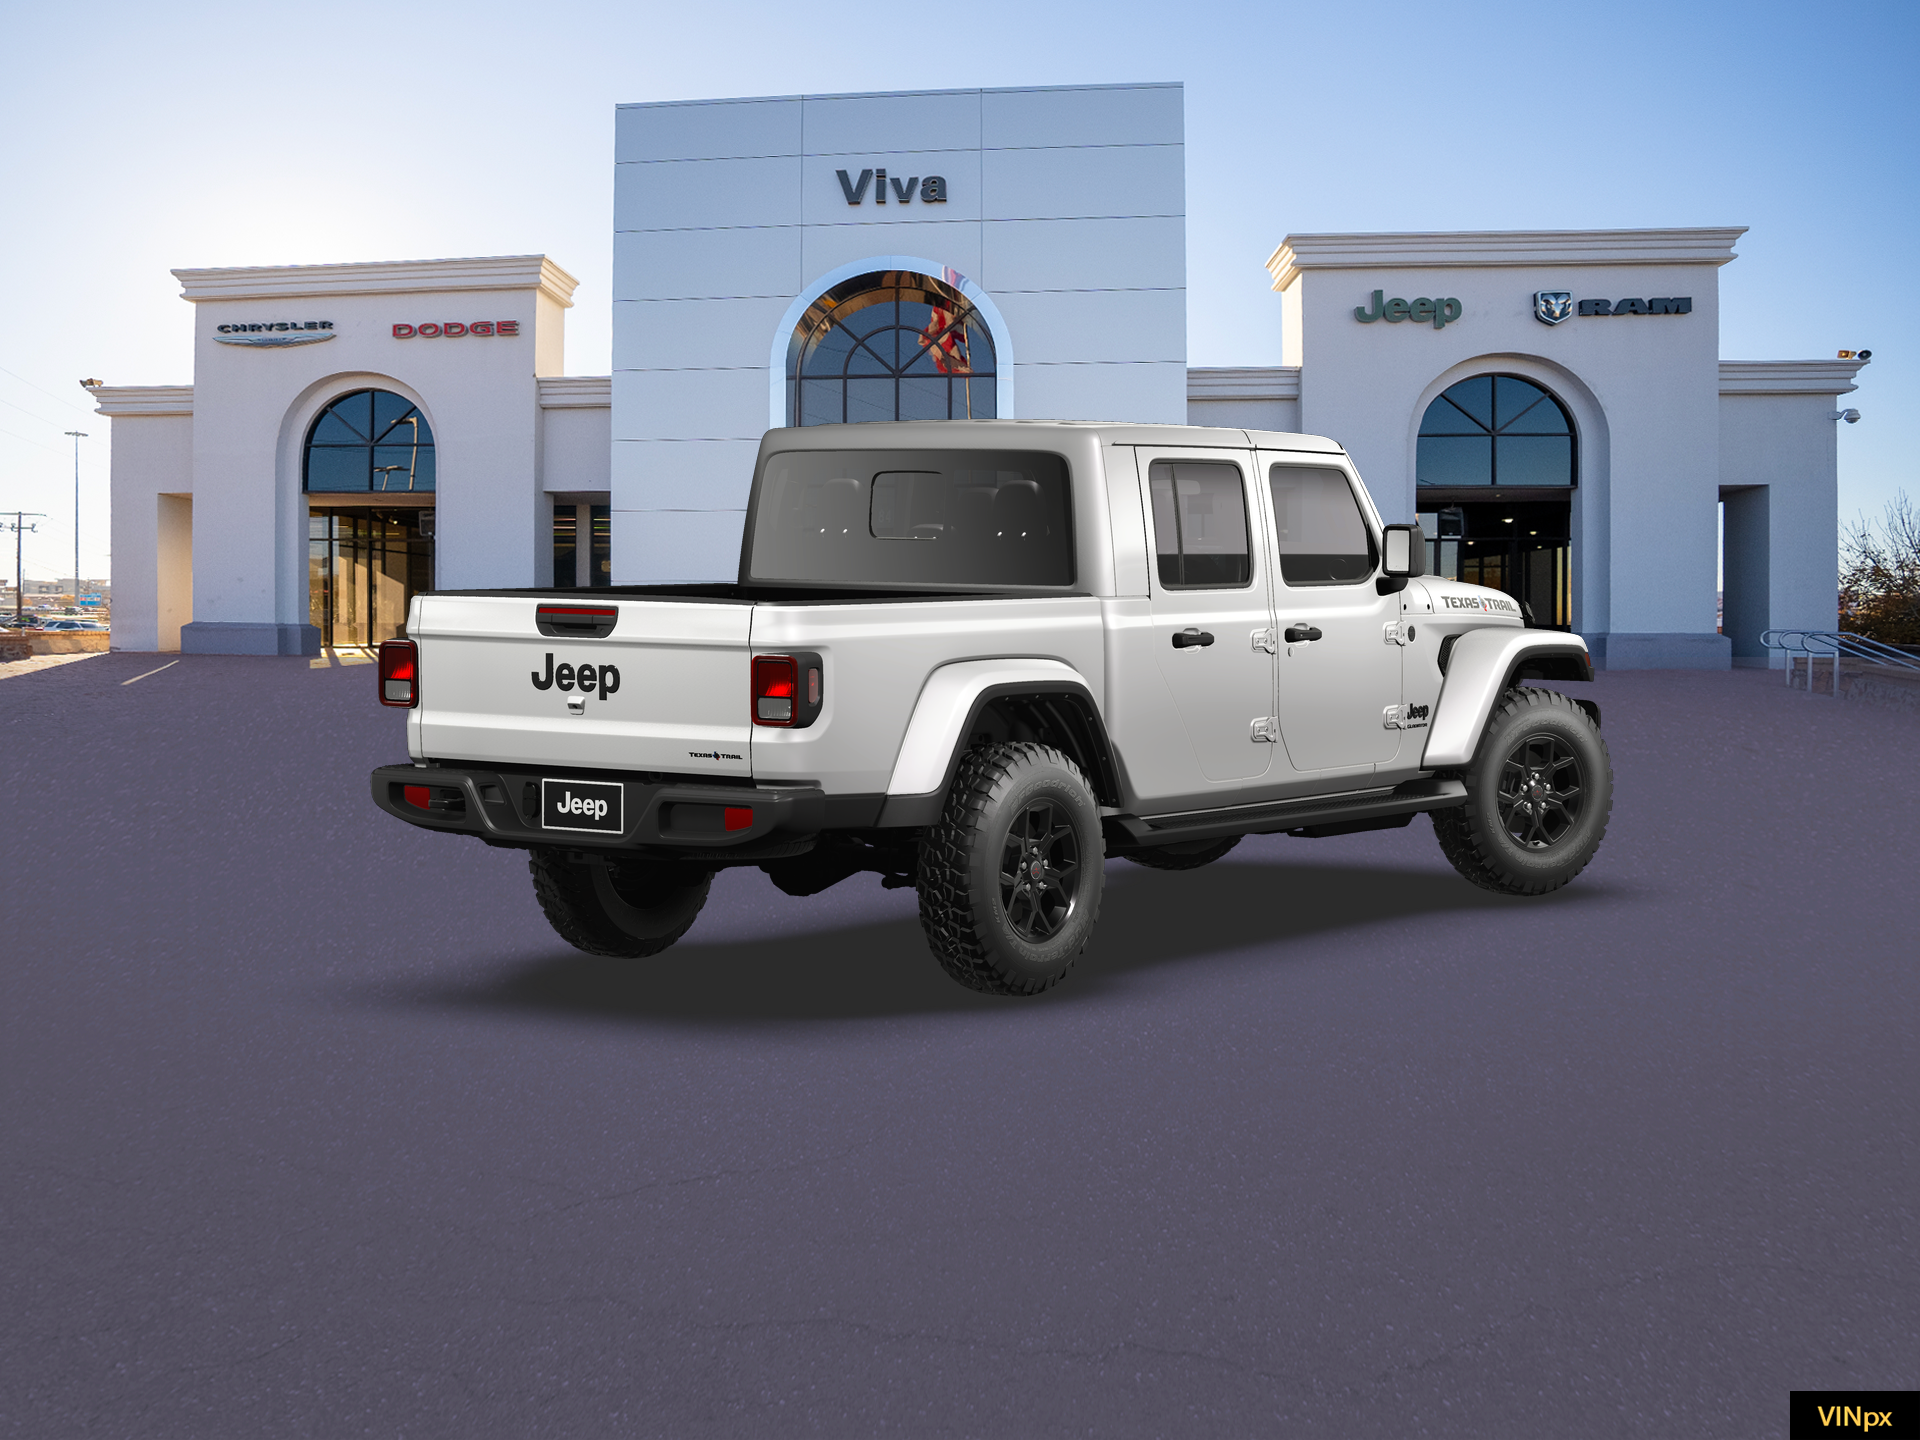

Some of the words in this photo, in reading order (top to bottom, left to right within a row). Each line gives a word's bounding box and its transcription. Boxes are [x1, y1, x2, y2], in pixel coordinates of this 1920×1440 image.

[835, 168, 948, 206] Viva
[1354, 289, 1463, 330] Jeep
[1578, 296, 1692, 316] RAM
[217, 320, 334, 334] CHRYSLER
[392, 320, 520, 338] DODGE
[1440, 595, 1480, 609] TEXAS
[1483, 597, 1517, 612] TRAIL
[531, 653, 620, 700] Jeep
[1407, 703, 1429, 720] Jeep
[557, 791, 608, 821] Jeep
